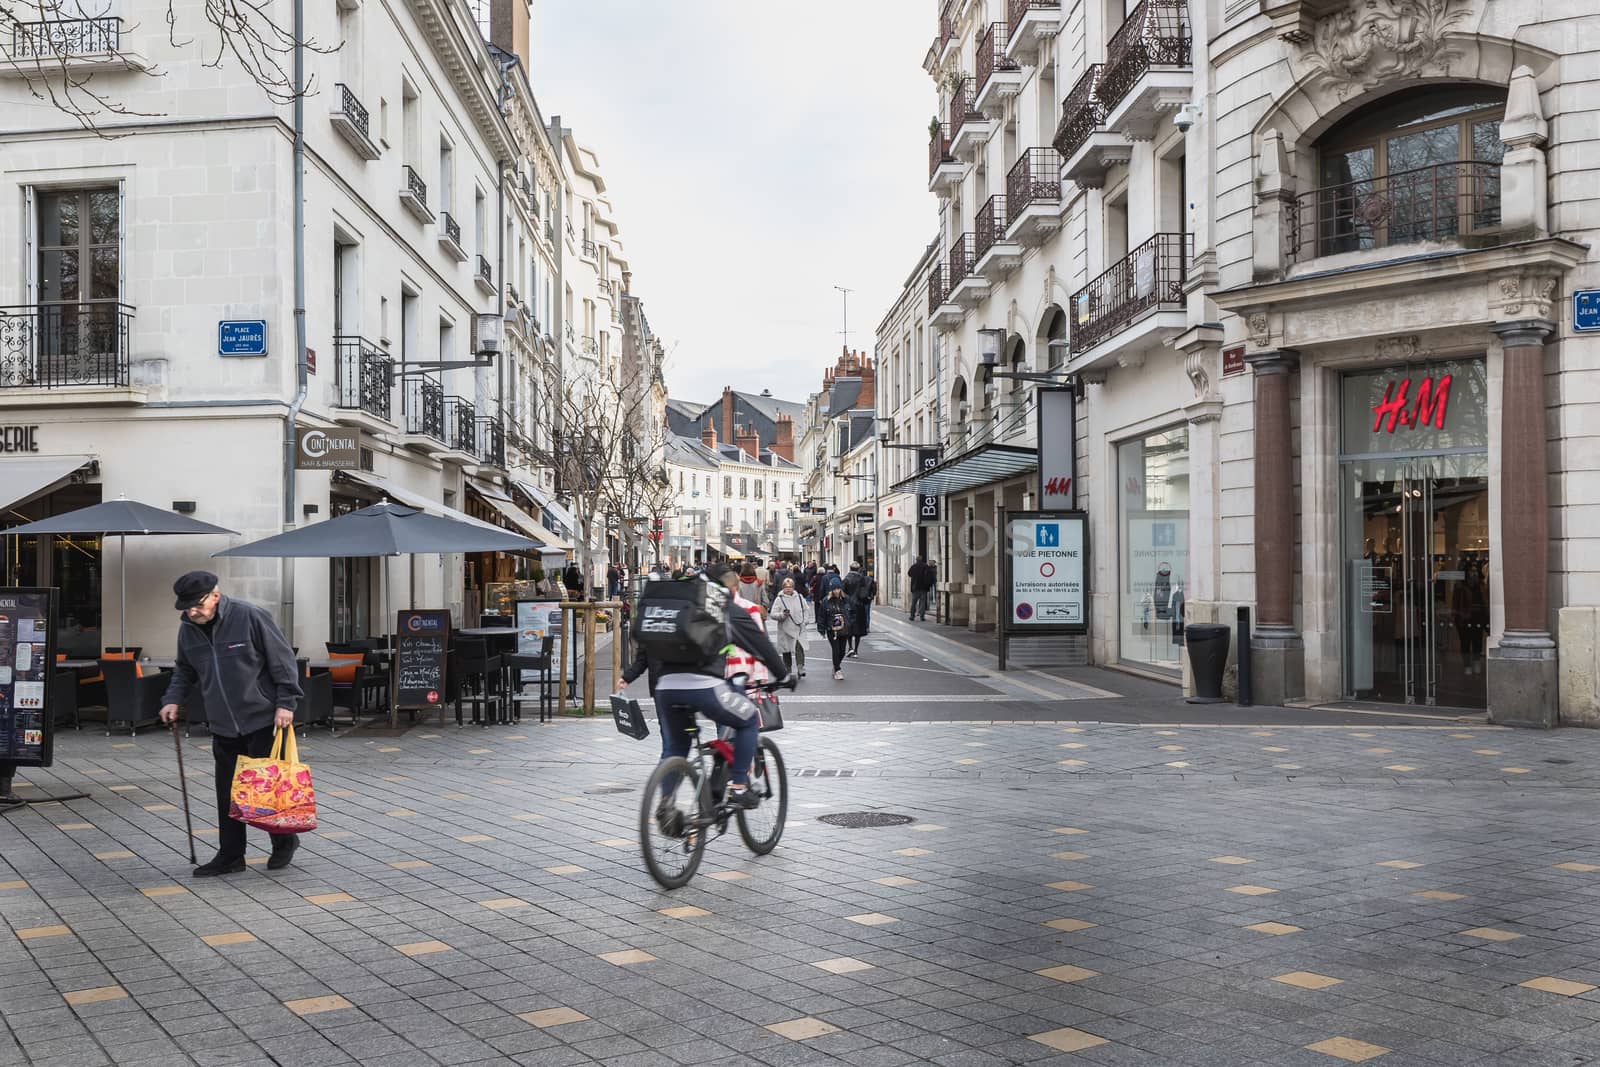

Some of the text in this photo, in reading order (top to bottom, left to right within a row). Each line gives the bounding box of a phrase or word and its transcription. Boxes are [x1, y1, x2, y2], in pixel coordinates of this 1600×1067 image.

[1579, 307, 1598, 315] JEAN
[1371, 374, 1453, 434] H&M
[302, 430, 356, 458] CONTINENTAL
[1044, 476, 1072, 497] H&M
[1017, 550, 1079, 558] VOIE PIETONNE
[644, 606, 681, 619] Uber
[640, 619, 677, 632] Eats
